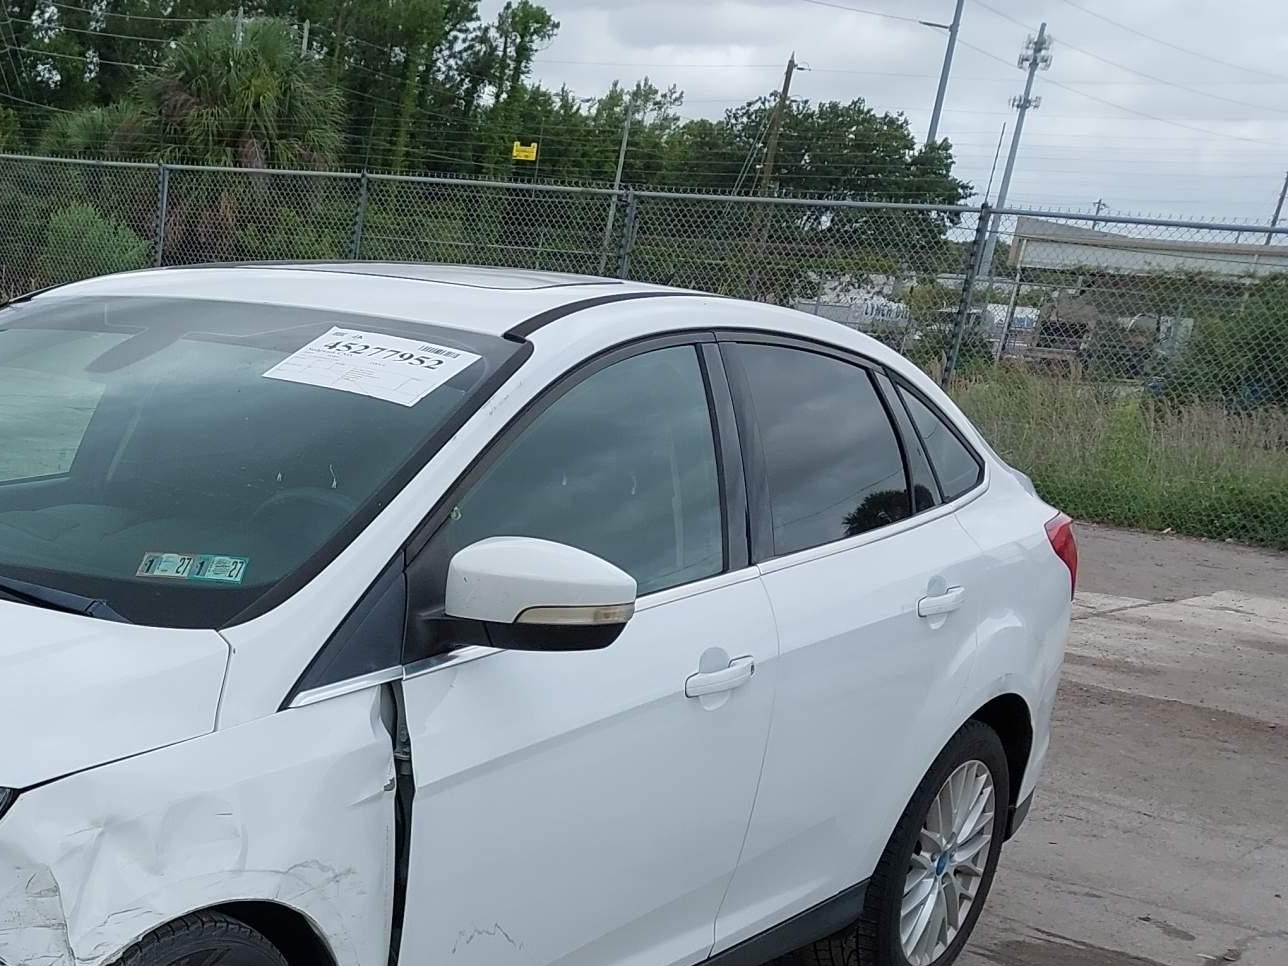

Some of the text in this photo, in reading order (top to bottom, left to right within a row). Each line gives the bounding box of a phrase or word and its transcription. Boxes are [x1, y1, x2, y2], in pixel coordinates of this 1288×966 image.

[324, 340, 444, 370] 45277952
[145, 558, 155, 573] 1
[176, 558, 192, 575] 27
[195, 560, 205, 576] 1
[228, 560, 244, 578] 27
